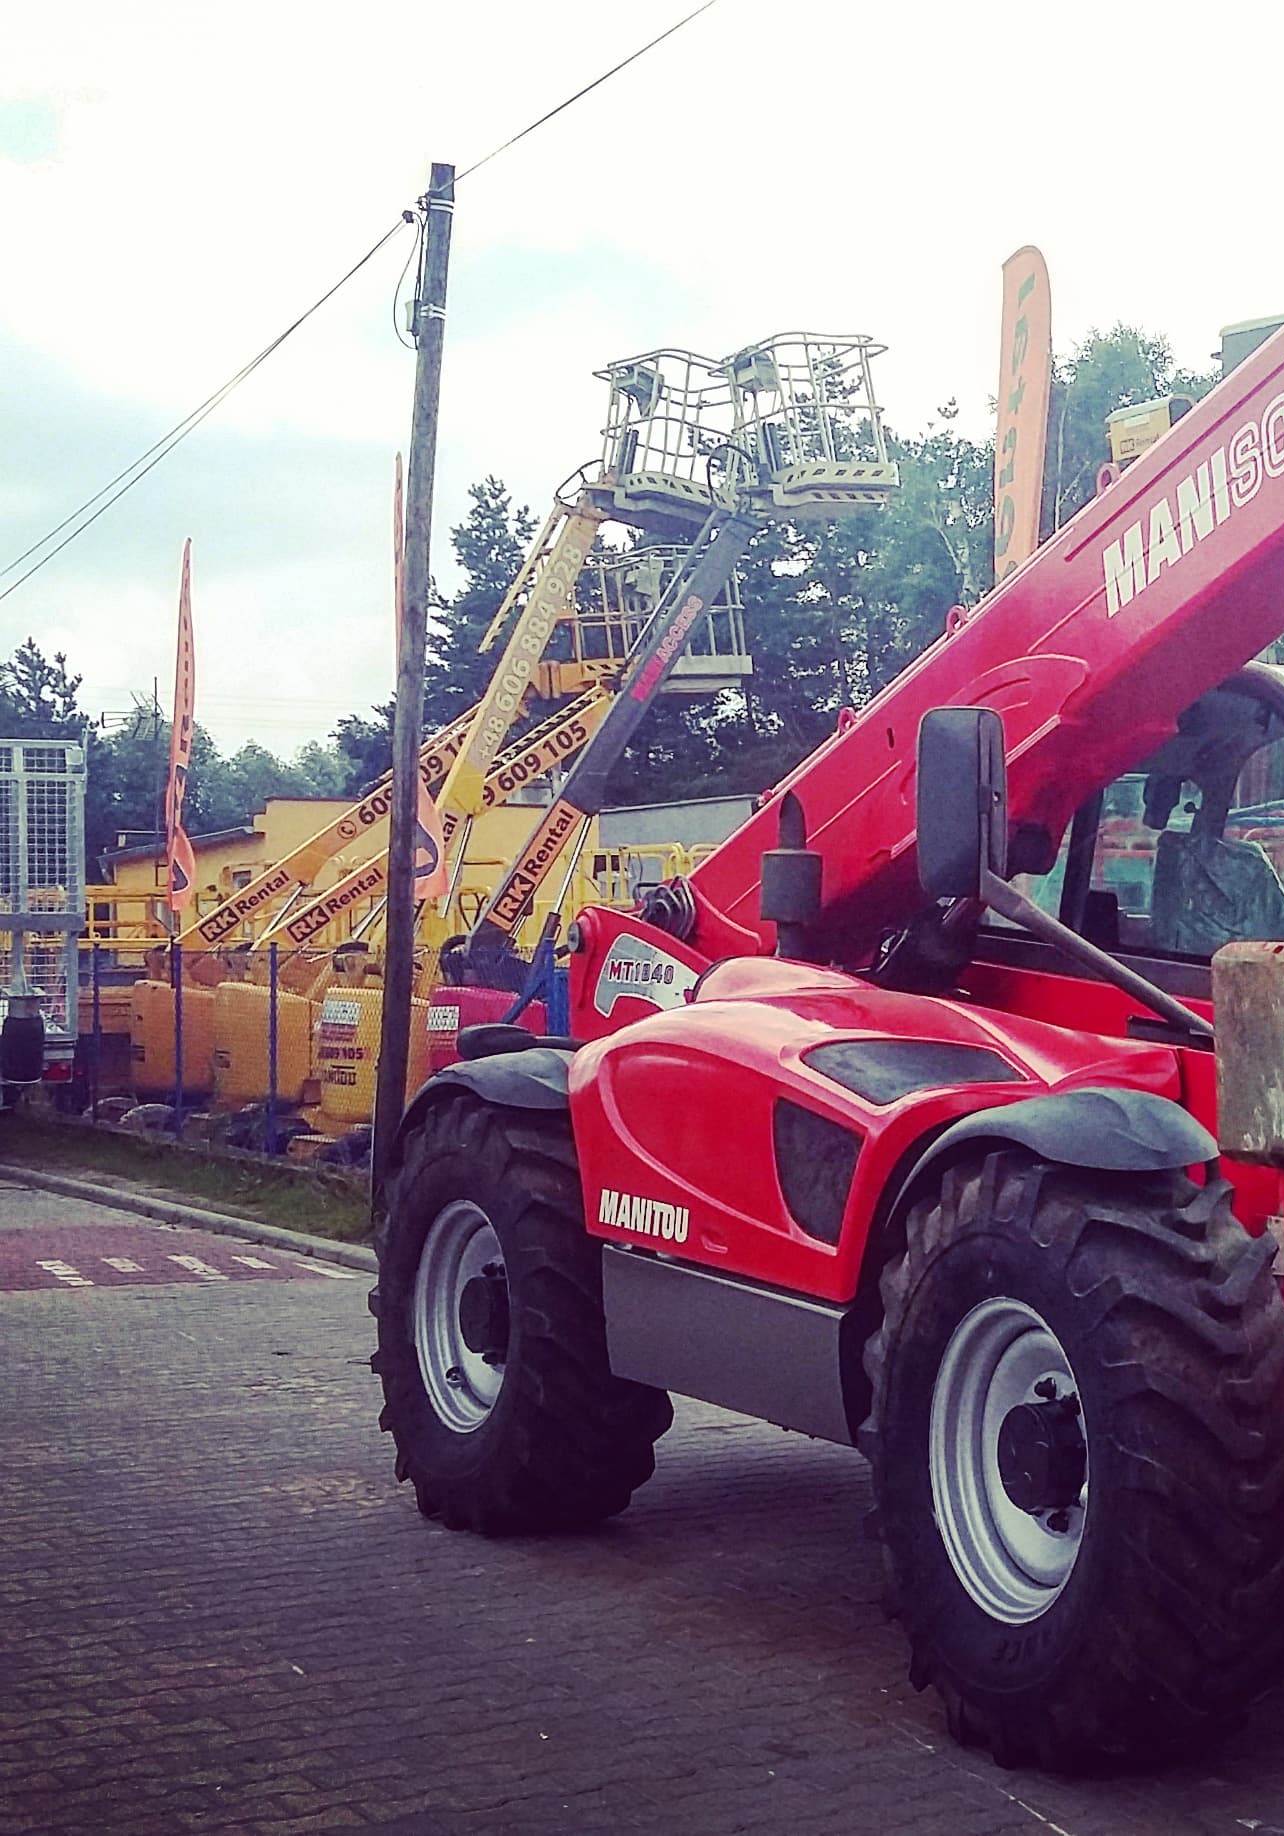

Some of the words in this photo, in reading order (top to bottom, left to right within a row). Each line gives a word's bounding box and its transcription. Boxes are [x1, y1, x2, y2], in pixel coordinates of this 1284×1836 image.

[495, 657, 531, 713] 606
[521, 602, 557, 656] 884
[546, 543, 583, 598] 928
[499, 753, 541, 792] 609
[543, 720, 588, 759] 105
[496, 875, 534, 921] RK
[524, 808, 574, 878] Rental
[200, 906, 240, 942] RK
[235, 870, 290, 915] Rental
[288, 906, 329, 942] RK
[325, 868, 384, 915] Rental
[598, 1188, 690, 1243] MANITOU
